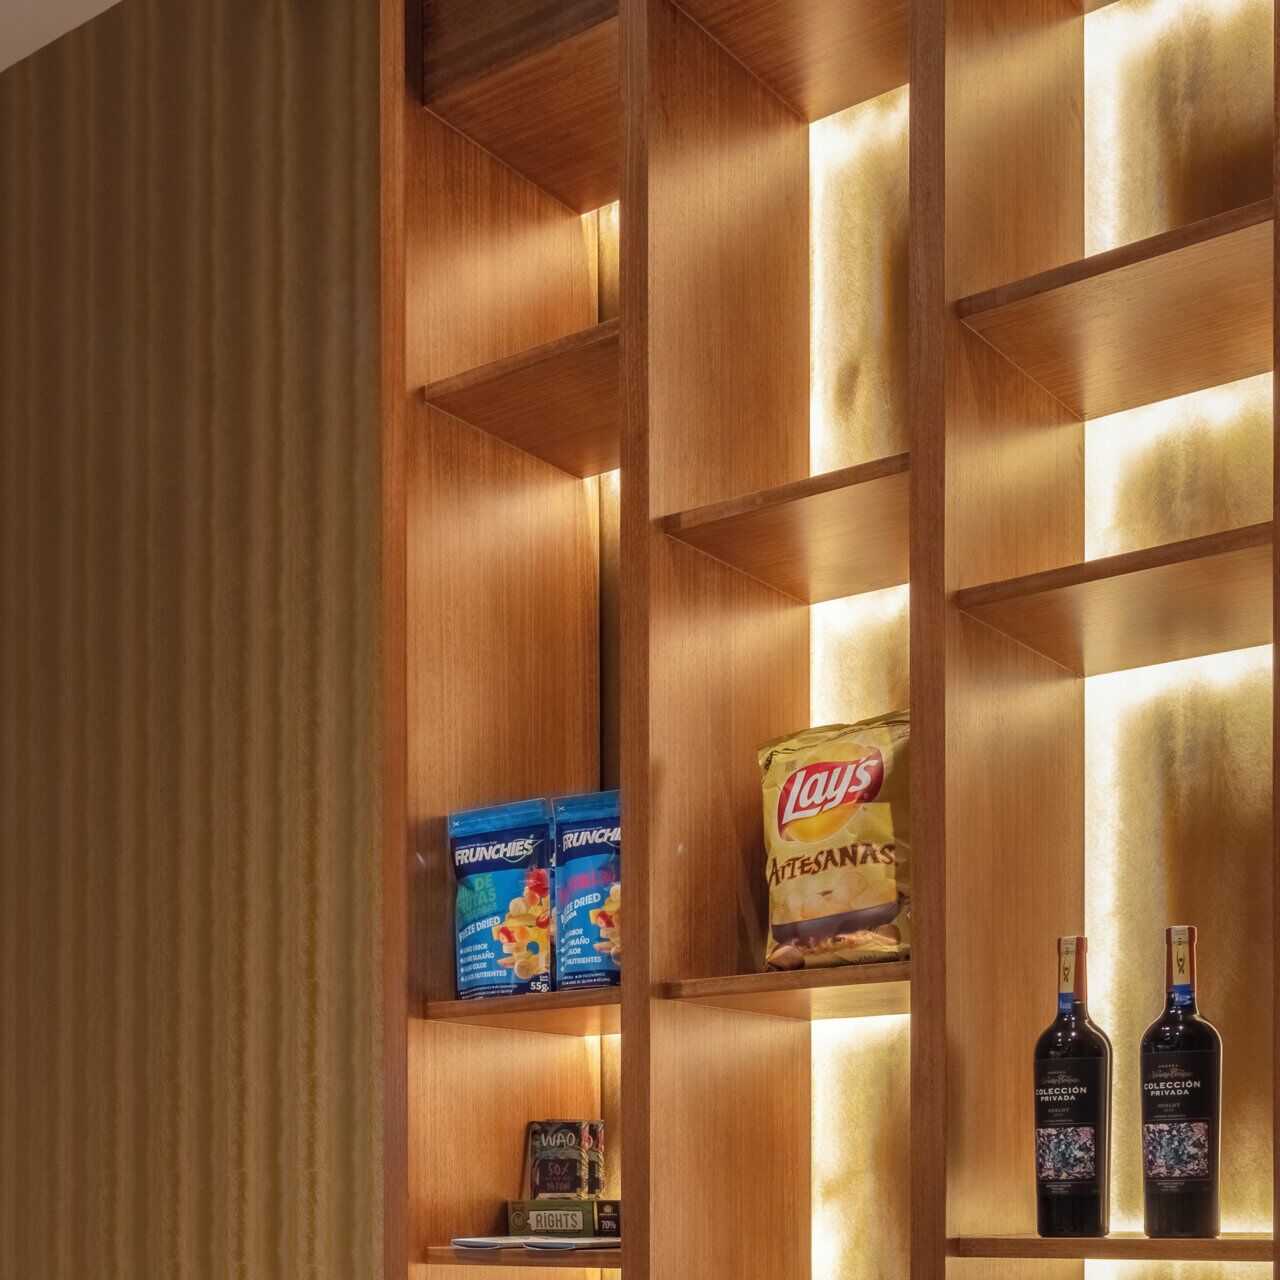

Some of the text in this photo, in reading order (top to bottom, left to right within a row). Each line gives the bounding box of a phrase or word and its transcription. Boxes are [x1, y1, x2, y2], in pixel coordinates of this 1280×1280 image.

[782, 757, 879, 826] Lay's
[562, 828, 621, 852] FRUNCHI
[456, 839, 534, 866] FRUNCHIES
[573, 892, 602, 907] DRIED
[476, 915, 501, 930] DRIED
[1036, 1086, 1087, 1096] COLECCIÓN
[1144, 1080, 1200, 1090] COLECCIÓN
[1151, 1089, 1189, 1097] PRIVADA
[601, 1220, 616, 1231] 70%
